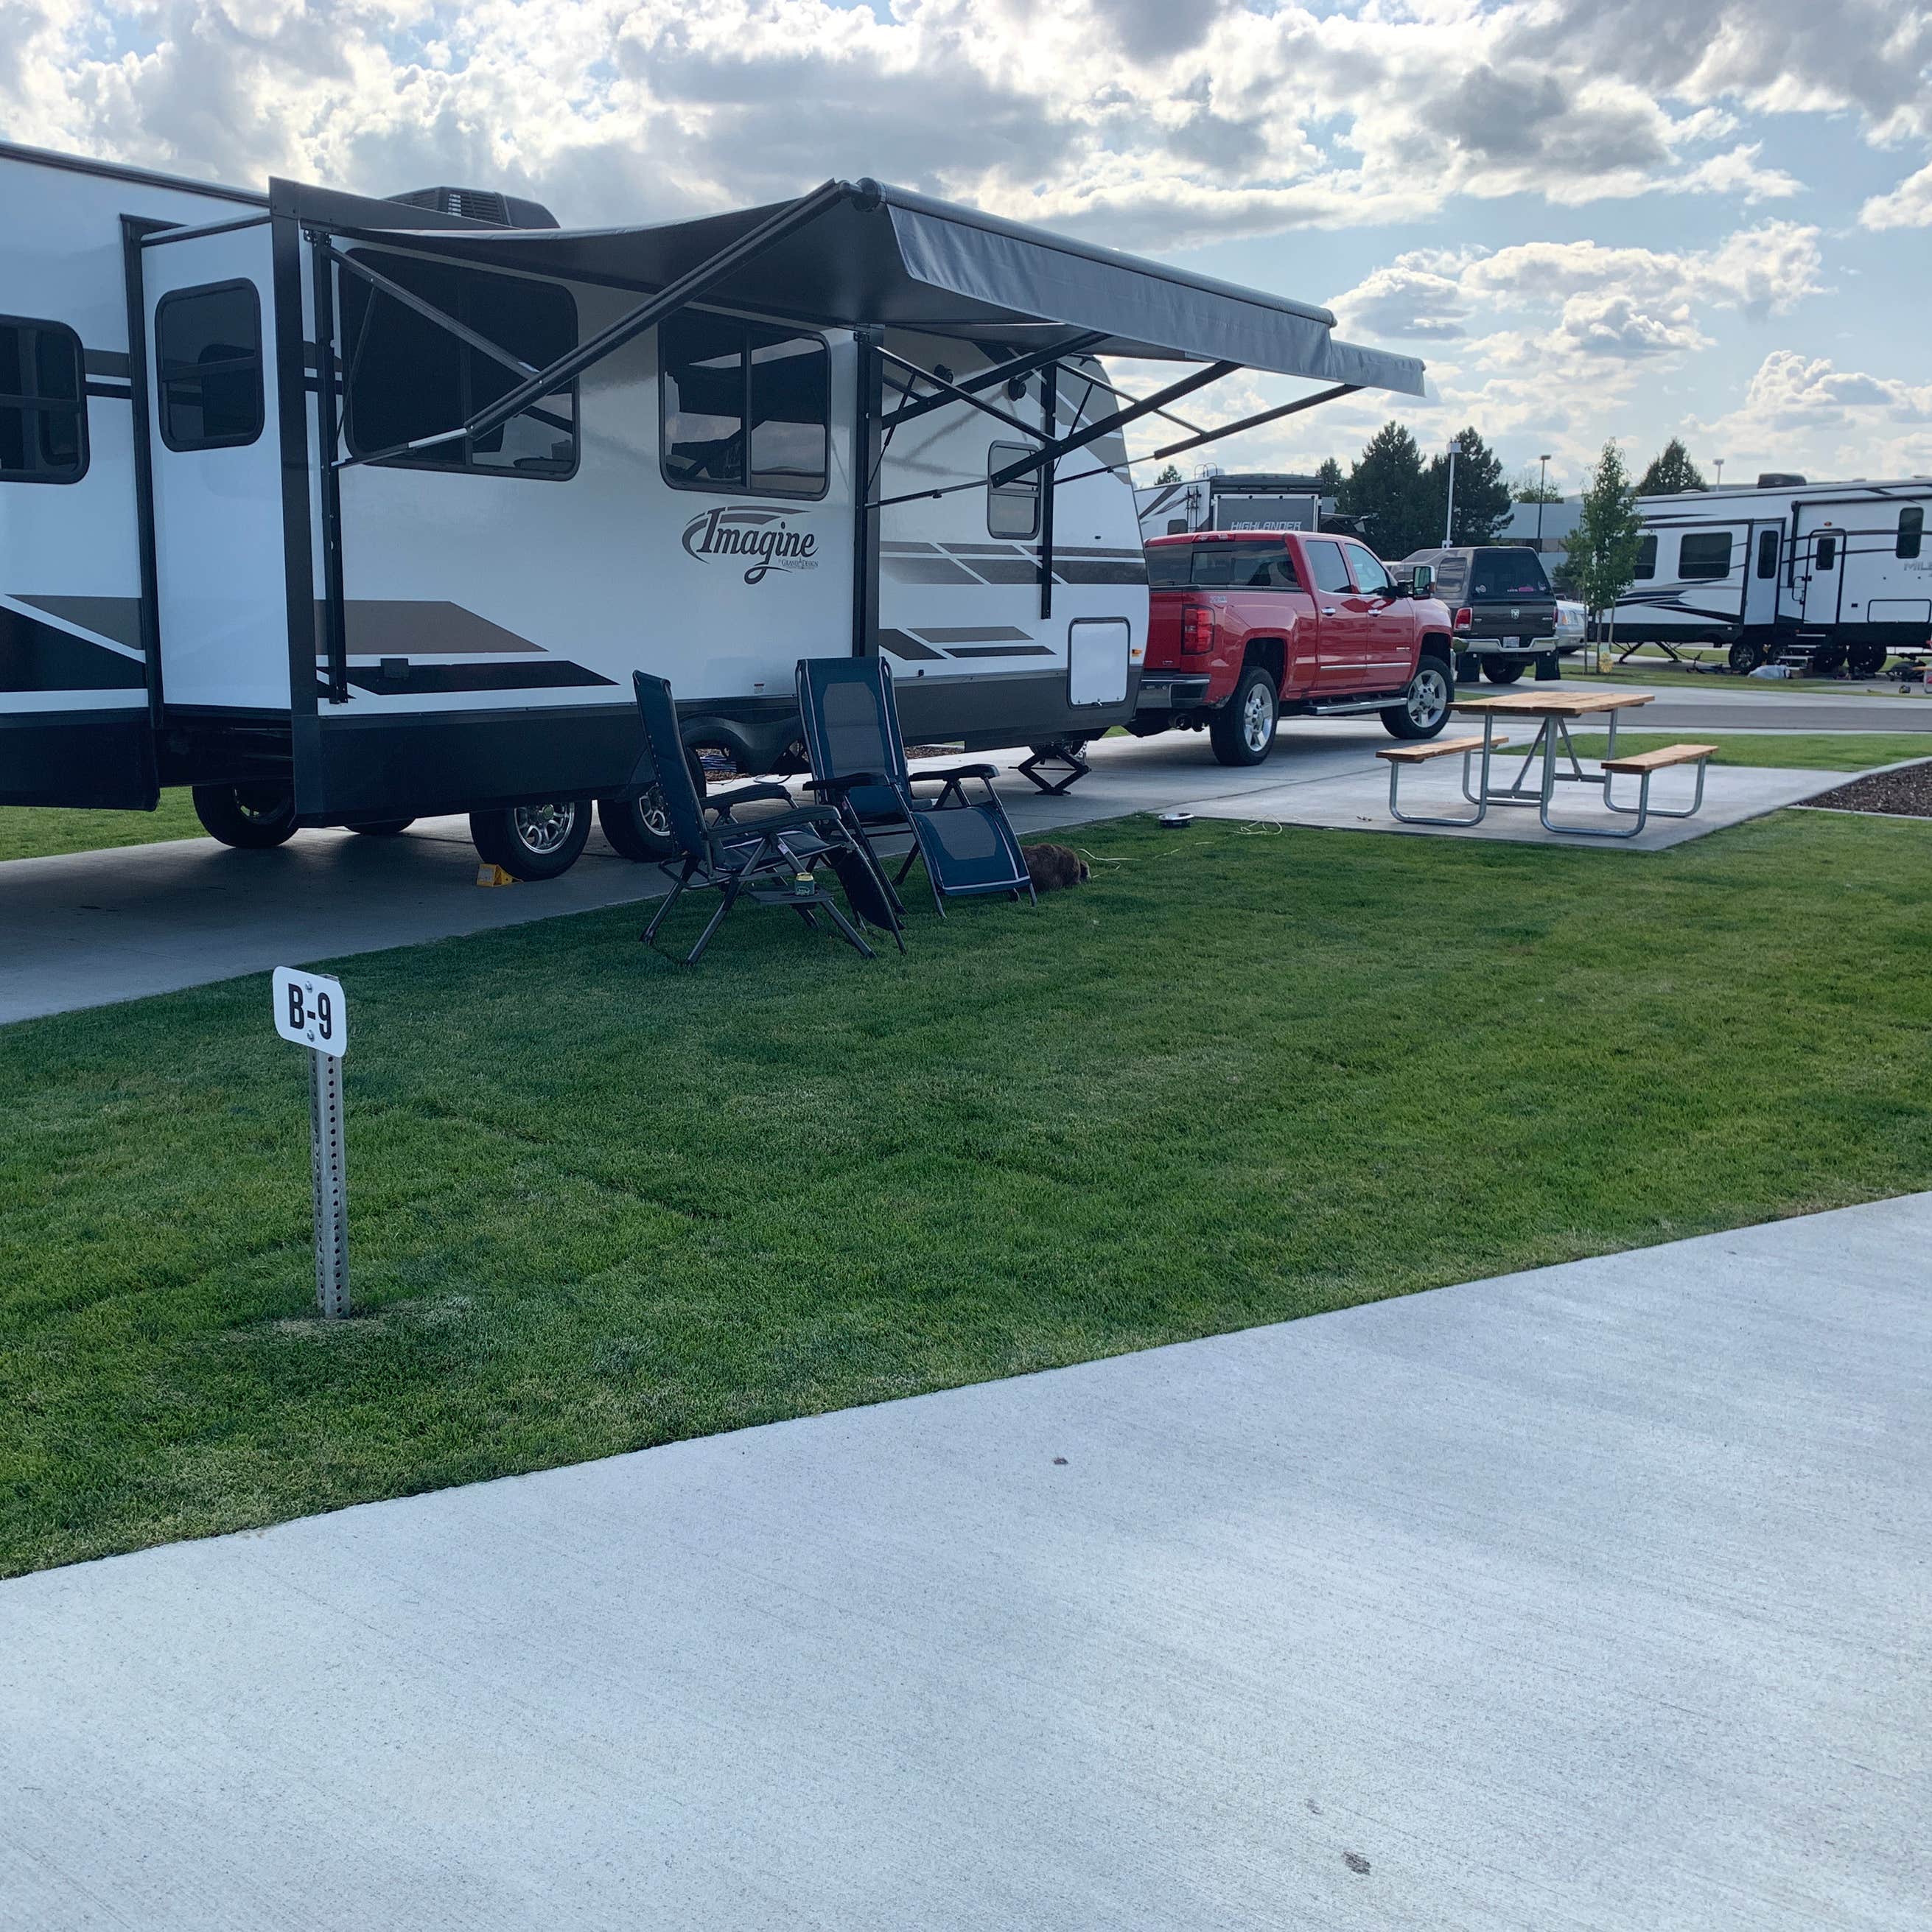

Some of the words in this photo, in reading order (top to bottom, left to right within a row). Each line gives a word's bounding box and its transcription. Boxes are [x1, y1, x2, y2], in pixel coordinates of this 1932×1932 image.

[696, 507, 819, 584] Imagine
[1231, 521, 1302, 531] HIGHLANDER
[288, 983, 332, 1040] B-9
